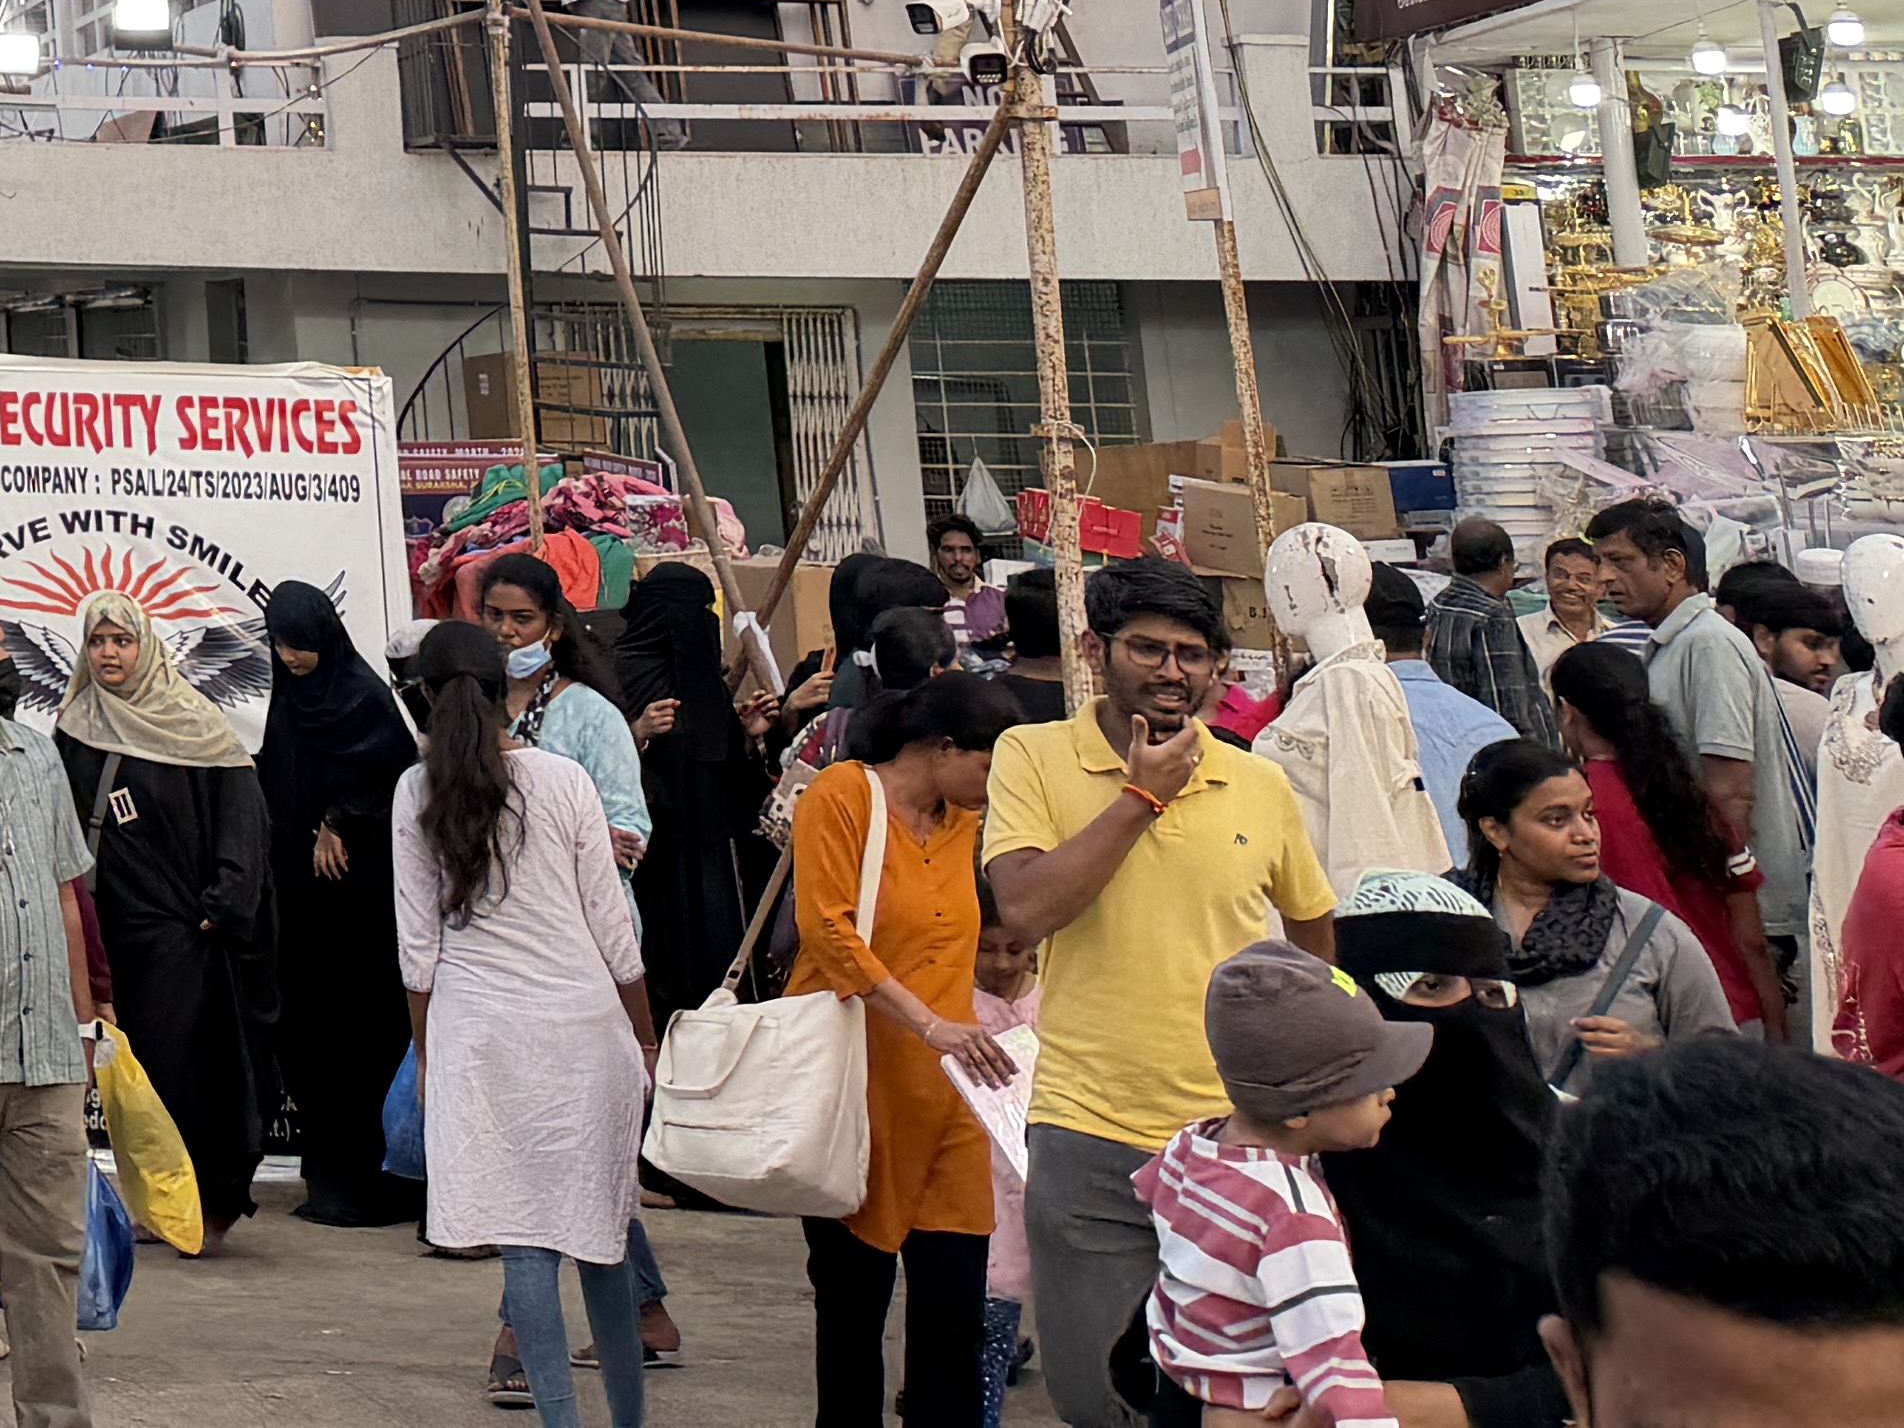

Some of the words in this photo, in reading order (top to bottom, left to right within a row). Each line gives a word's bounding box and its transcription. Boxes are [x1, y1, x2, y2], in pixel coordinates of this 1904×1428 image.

[176, 395, 362, 459] SERVICES
[0, 465, 89, 496] COMPANY
[110, 468, 361, 504] PSA/L/24/TS/2023/AUG/3/409
[415, 469, 441, 481] ROAD
[444, 468, 480, 480] SAFETY
[64, 509, 155, 540] WITH
